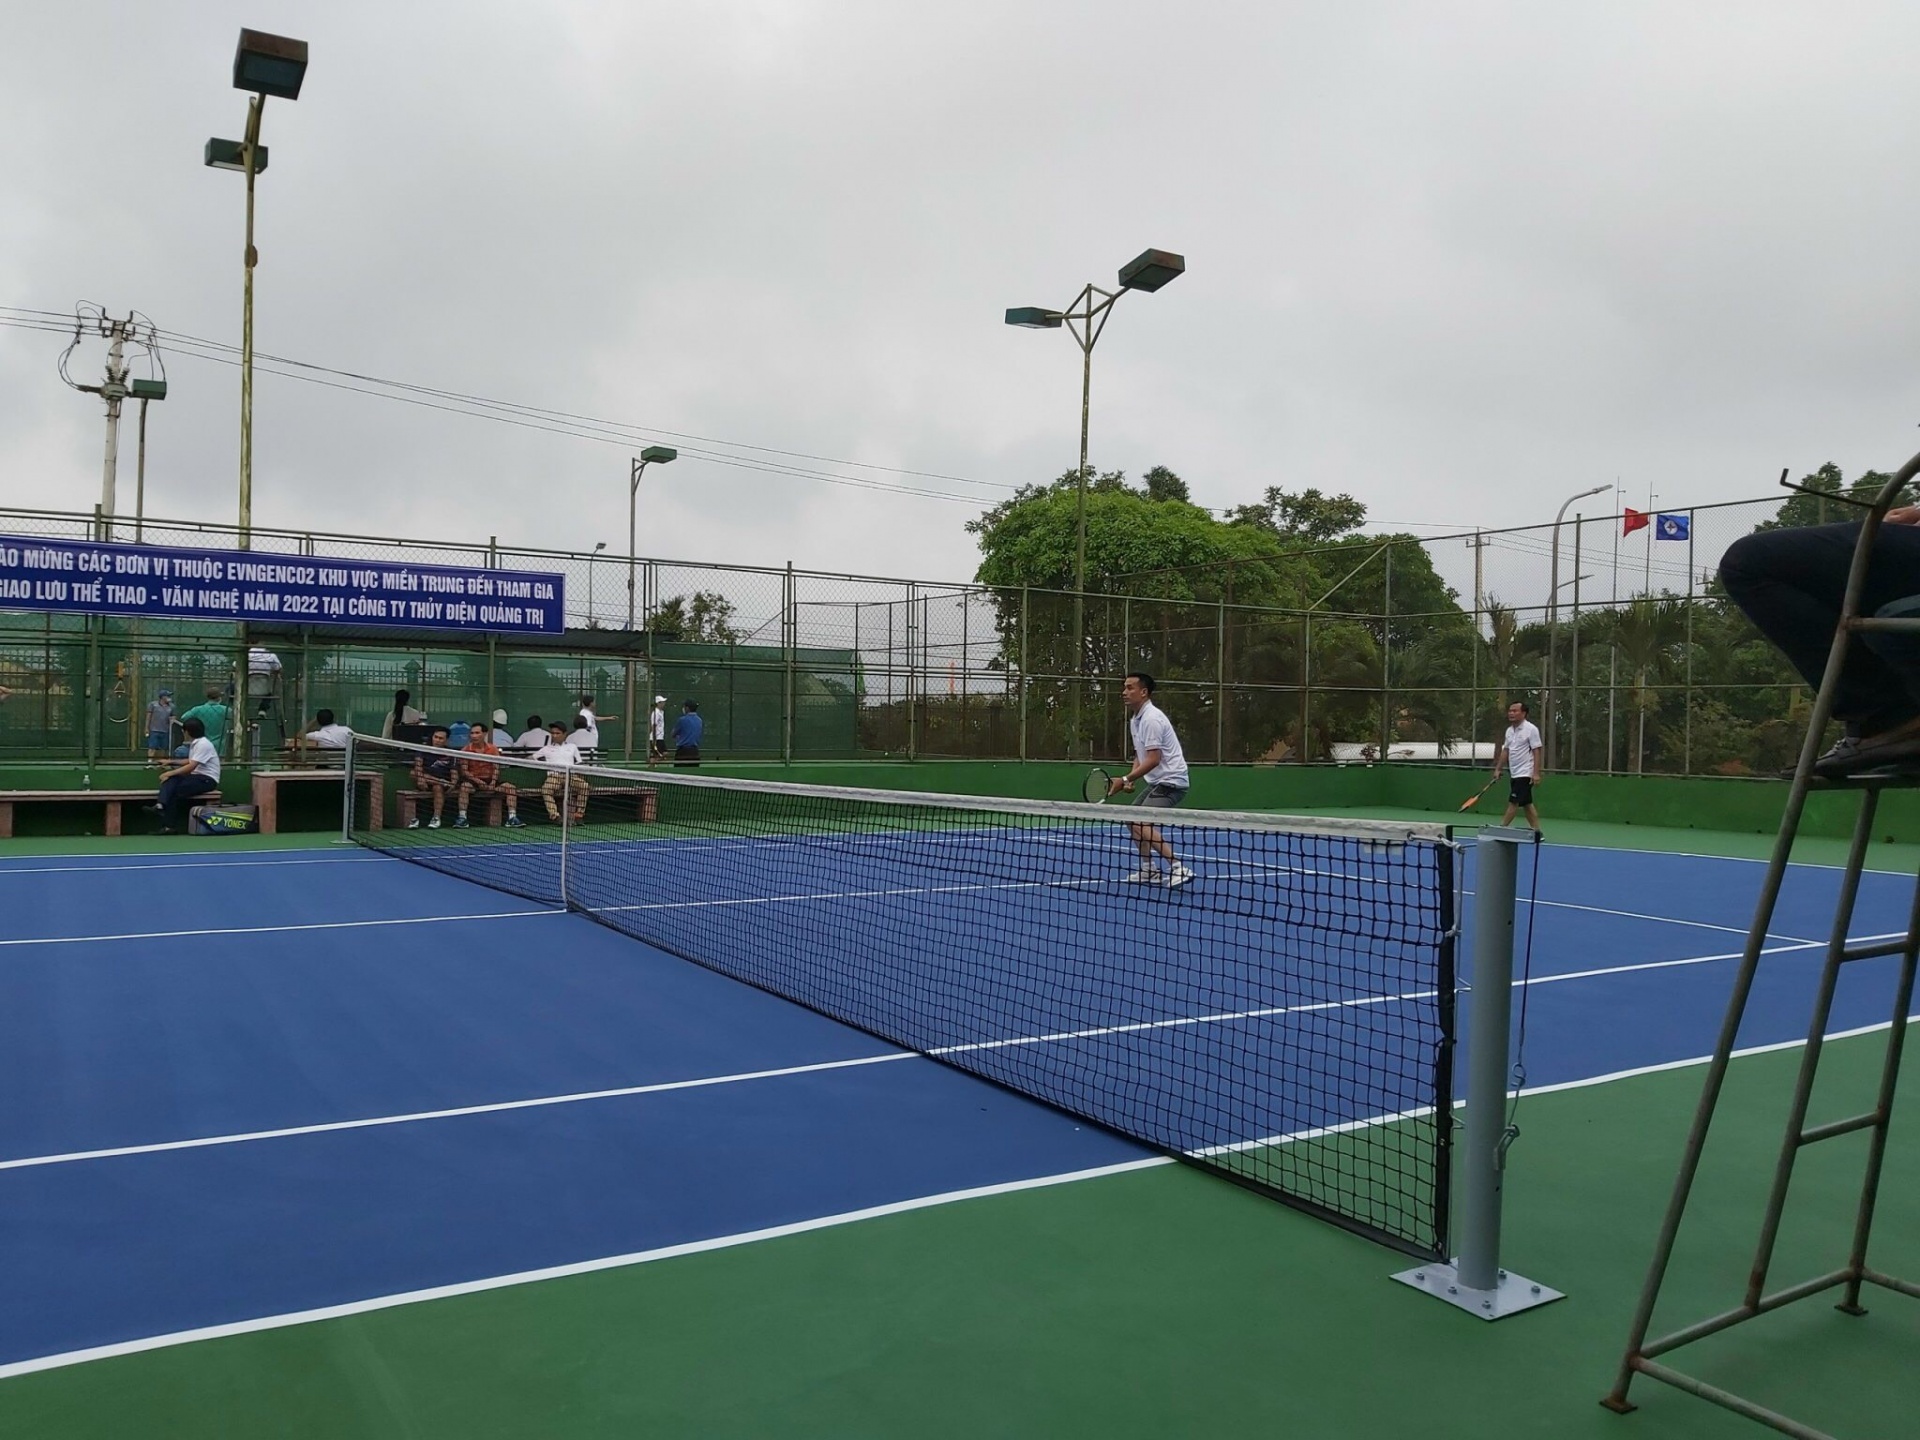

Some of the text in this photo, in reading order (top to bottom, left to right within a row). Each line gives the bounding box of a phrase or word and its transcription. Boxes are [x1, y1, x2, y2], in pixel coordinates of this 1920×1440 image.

[24, 547, 73, 570] MỪNG
[79, 550, 110, 572] CÁC
[116, 555, 148, 574] ĐƠN
[154, 558, 168, 579] VỊ
[173, 558, 222, 582] THUỘC
[228, 563, 314, 584] EVNGENCO2
[319, 569, 347, 586] KHU
[351, 570, 378, 591] VỰC
[383, 569, 417, 590] MIỀN
[421, 575, 464, 593] TRUNG
[468, 574, 493, 595] ĐẾN
[497, 580, 530, 598] THAM
[534, 583, 553, 599] GIA
[0, 580, 30, 598] IAO
[36, 581, 66, 600] LƯU
[72, 577, 102, 602] THỂ
[106, 585, 146, 604] THAO
[163, 585, 193, 606] VĂN
[199, 589, 239, 613] NGHỆ
[244, 590, 278, 611] NĂM
[283, 595, 318, 613] 2022
[323, 597, 344, 617] TẠI
[349, 596, 386, 616] CÔNG
[391, 601, 406, 617] TY
[410, 598, 442, 619] THỦY
[446, 601, 476, 624] ĐIỆN
[481, 602, 521, 623] QUẢNG
[525, 609, 543, 628] TRỊ
[223, 818, 247, 829] YONEX
